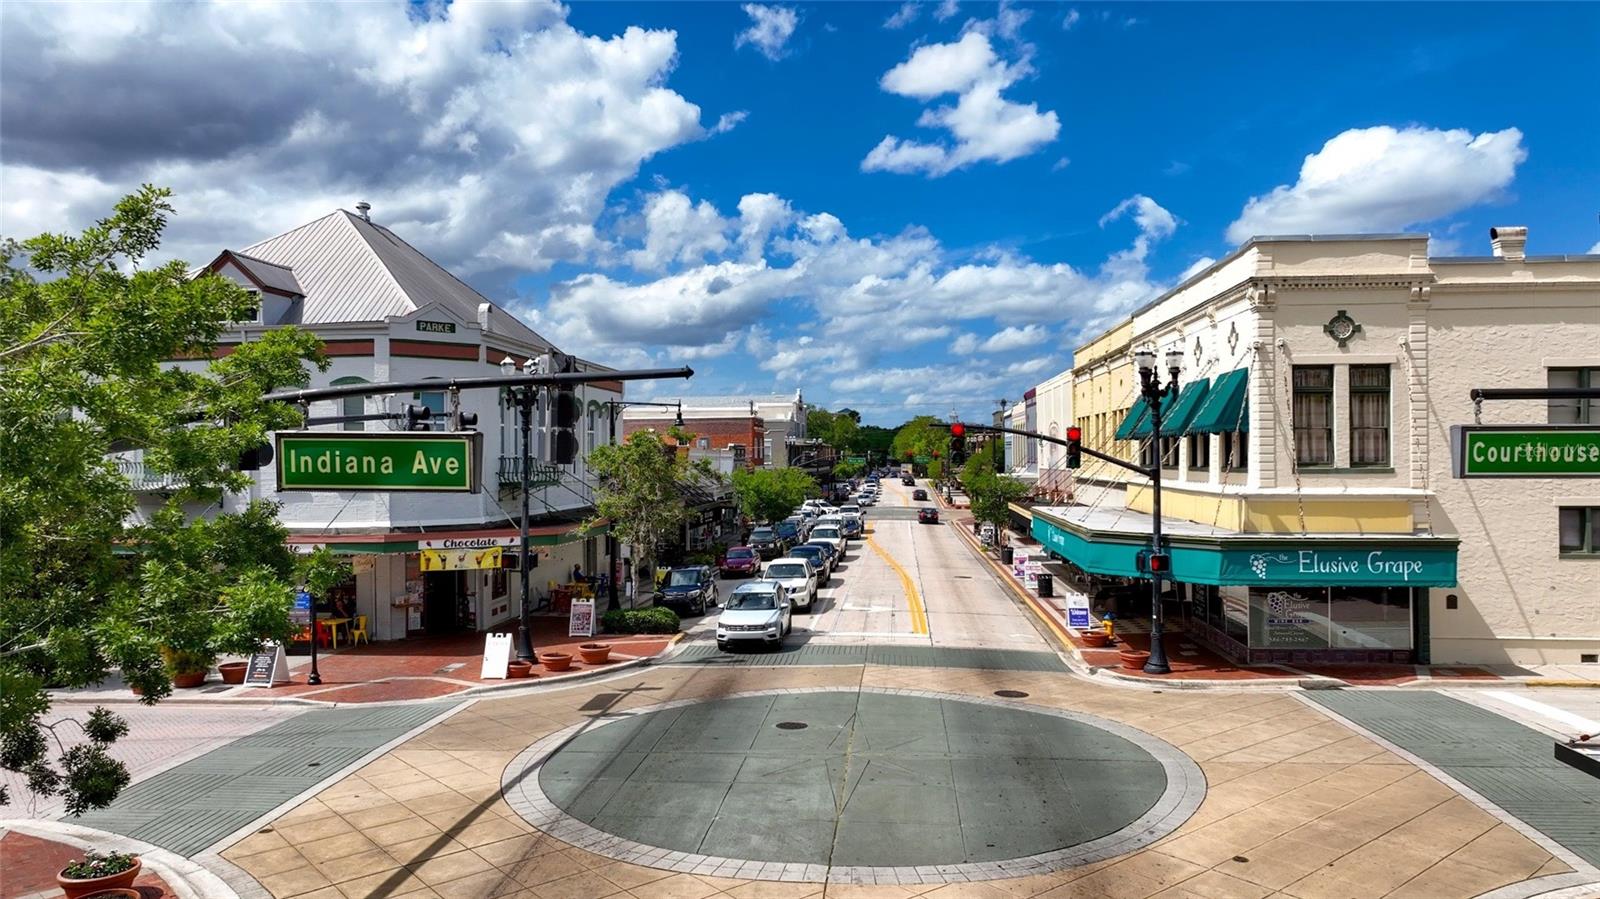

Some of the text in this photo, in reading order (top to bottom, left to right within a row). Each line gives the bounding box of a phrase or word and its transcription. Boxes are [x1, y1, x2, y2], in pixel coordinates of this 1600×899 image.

[419, 322, 452, 333] PARKE
[1473, 442, 1600, 462] Courthouse
[290, 449, 460, 475] Indiana Ave
[443, 538, 498, 548] Chocolate
[1298, 550, 1423, 581] Elusive Grape
[1284, 599, 1310, 609] Elusive
